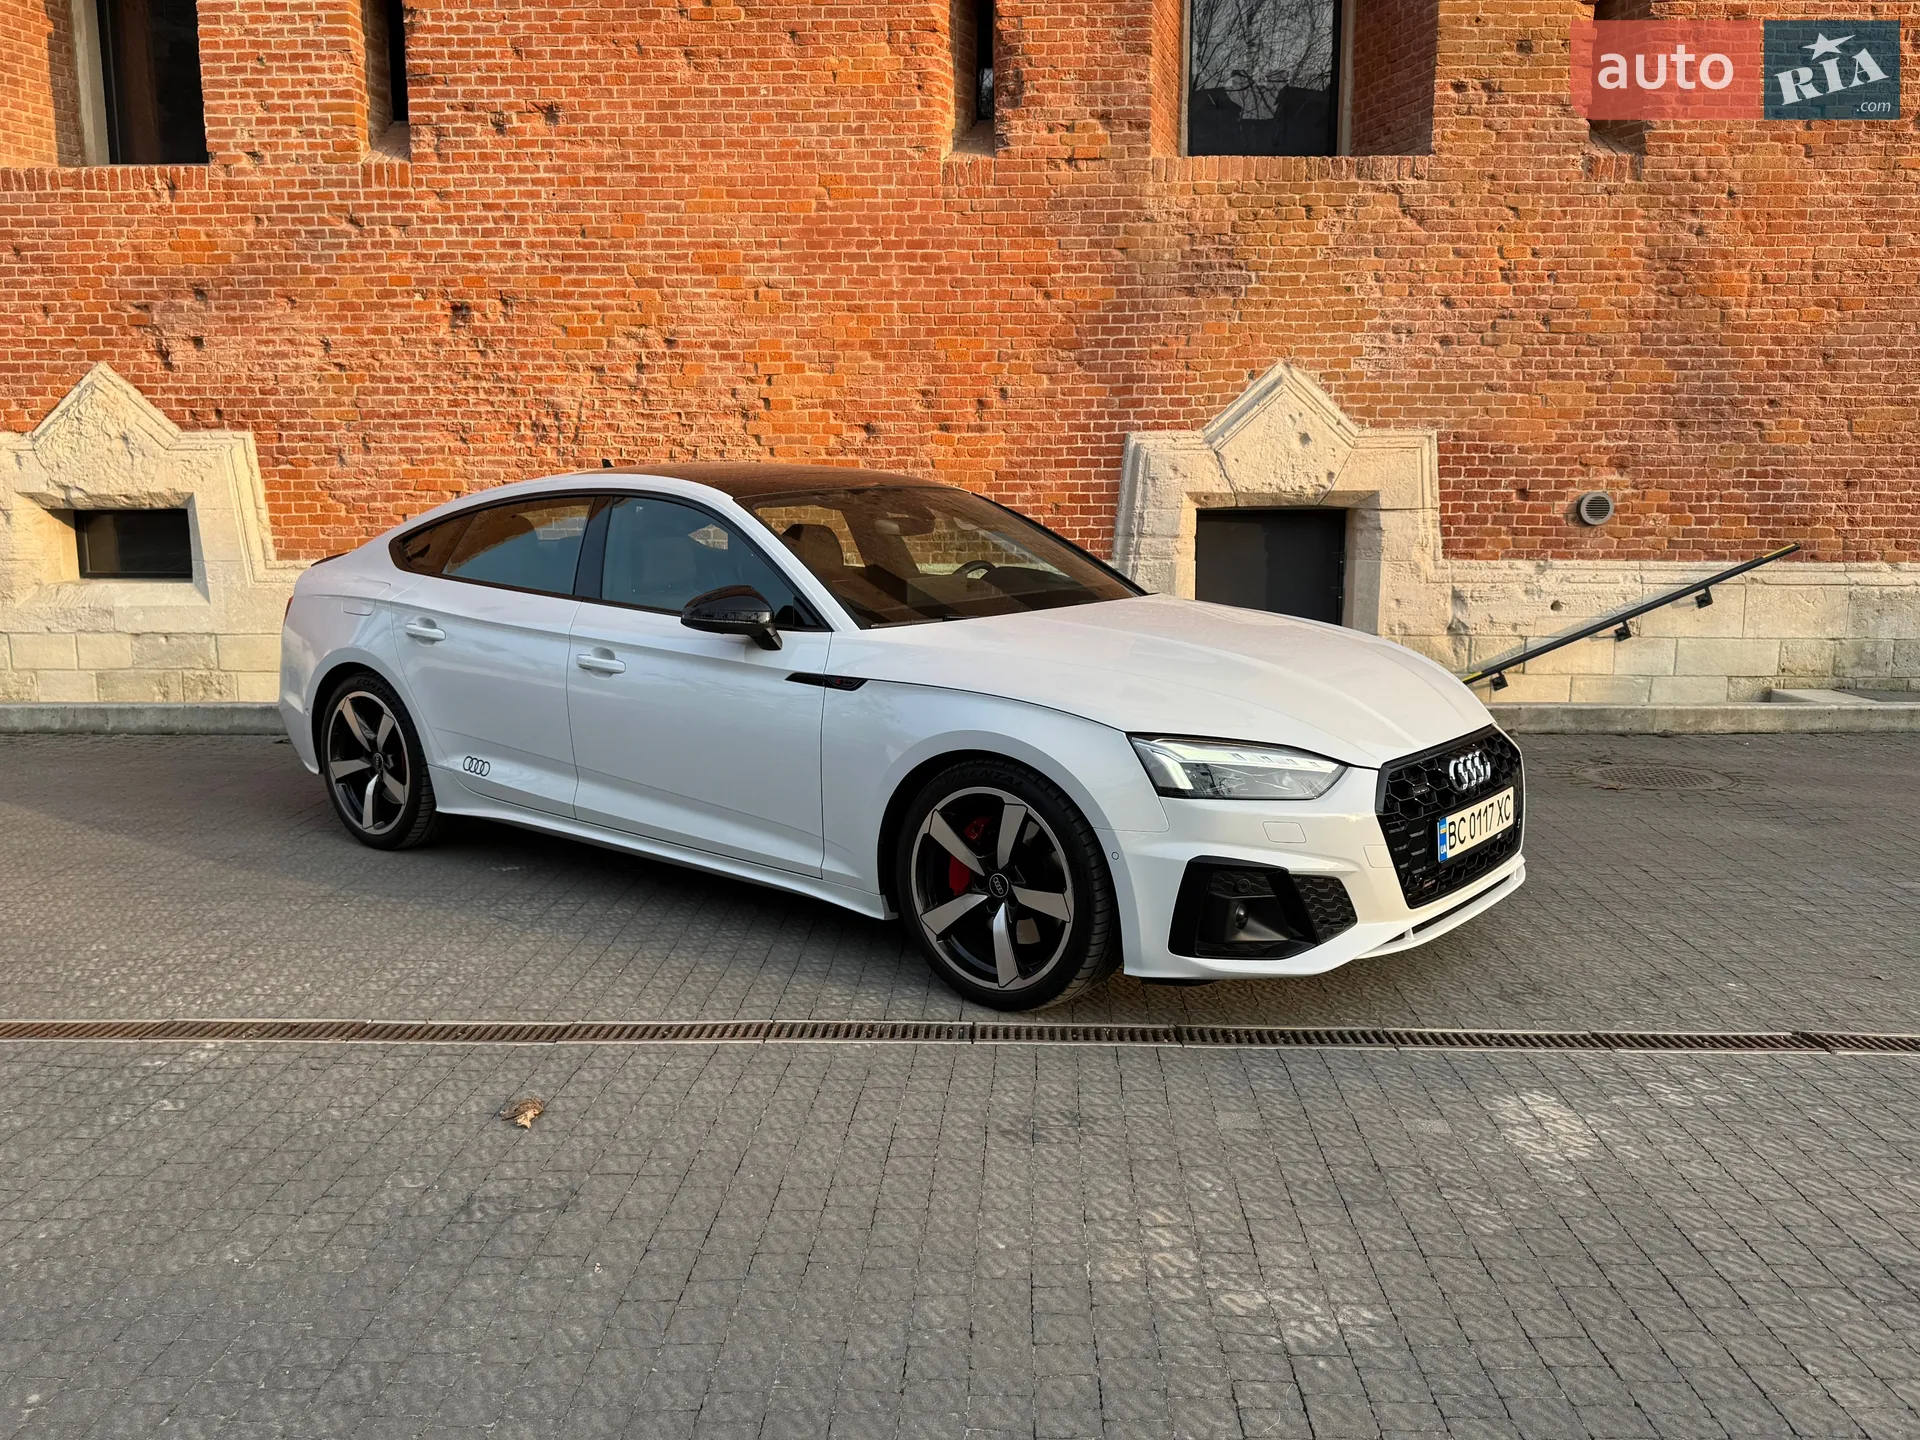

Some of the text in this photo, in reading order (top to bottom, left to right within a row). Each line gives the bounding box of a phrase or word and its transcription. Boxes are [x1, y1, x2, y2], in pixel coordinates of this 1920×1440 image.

[1448, 794, 1511, 851] BC 0117 XC
[1440, 843, 1447, 854] UA
